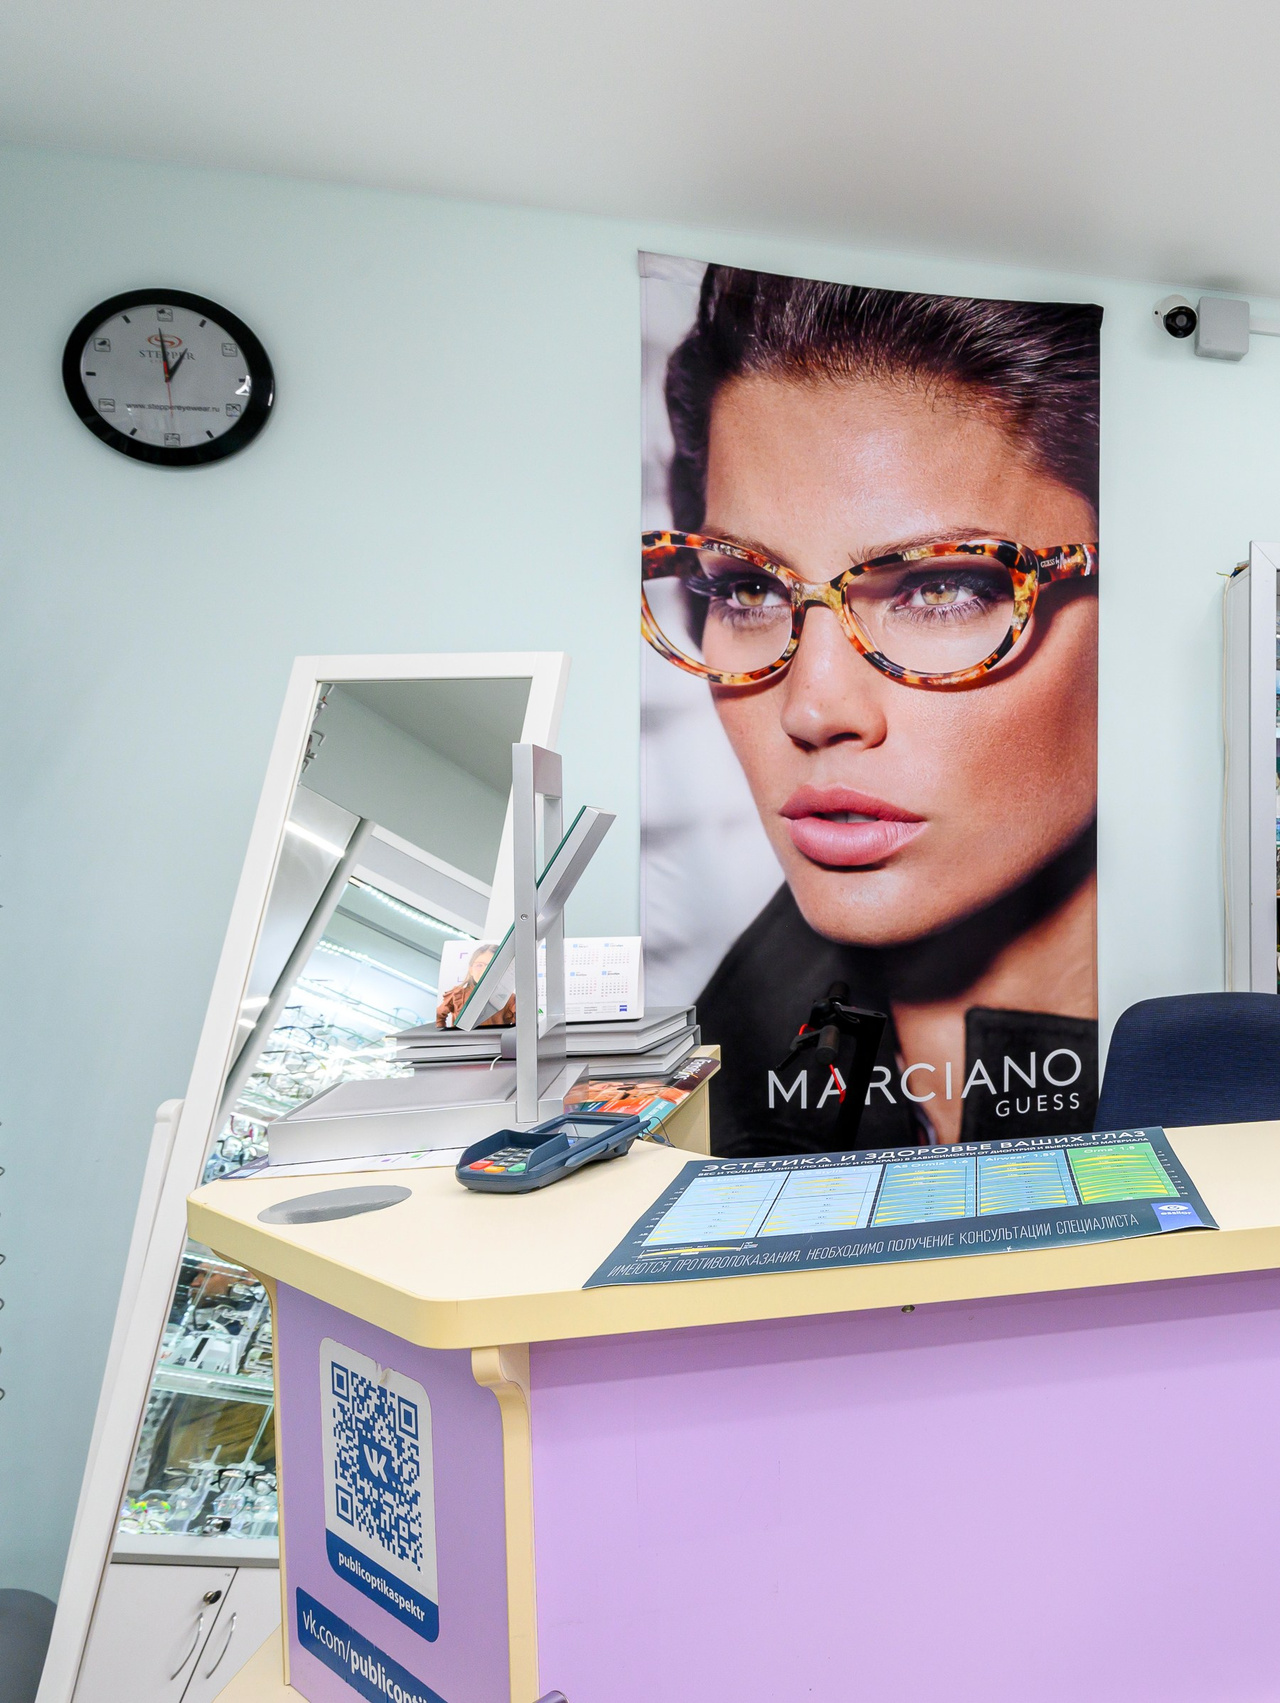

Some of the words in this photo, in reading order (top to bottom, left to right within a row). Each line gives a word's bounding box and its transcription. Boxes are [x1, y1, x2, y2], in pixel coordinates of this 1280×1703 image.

[768, 1048, 1082, 1109] MARCIANO
[996, 1092, 1080, 1117] GUESS
[702, 1157, 832, 1171] ЭСТЕТИКА
[865, 1143, 992, 1159] ЗДОРОВЬЕ
[1001, 1135, 1084, 1148] ВАШИХ
[1092, 1131, 1146, 1140] ГЛАЗ
[912, 1152, 977, 1160] ЗАВИСИМОСТИ
[606, 1260, 669, 1278] ИМЕЮТСЯ
[806, 1242, 885, 1260] НЕОБХОДИМО
[887, 1233, 955, 1252] ПОЛУЧЕНИЕ
[959, 1223, 1052, 1244] КОНСУЛЬТАЦИИ
[1056, 1213, 1139, 1235] СПЕЦИАЛИСТА
[338, 1550, 426, 1622] publicoptikaspektr
